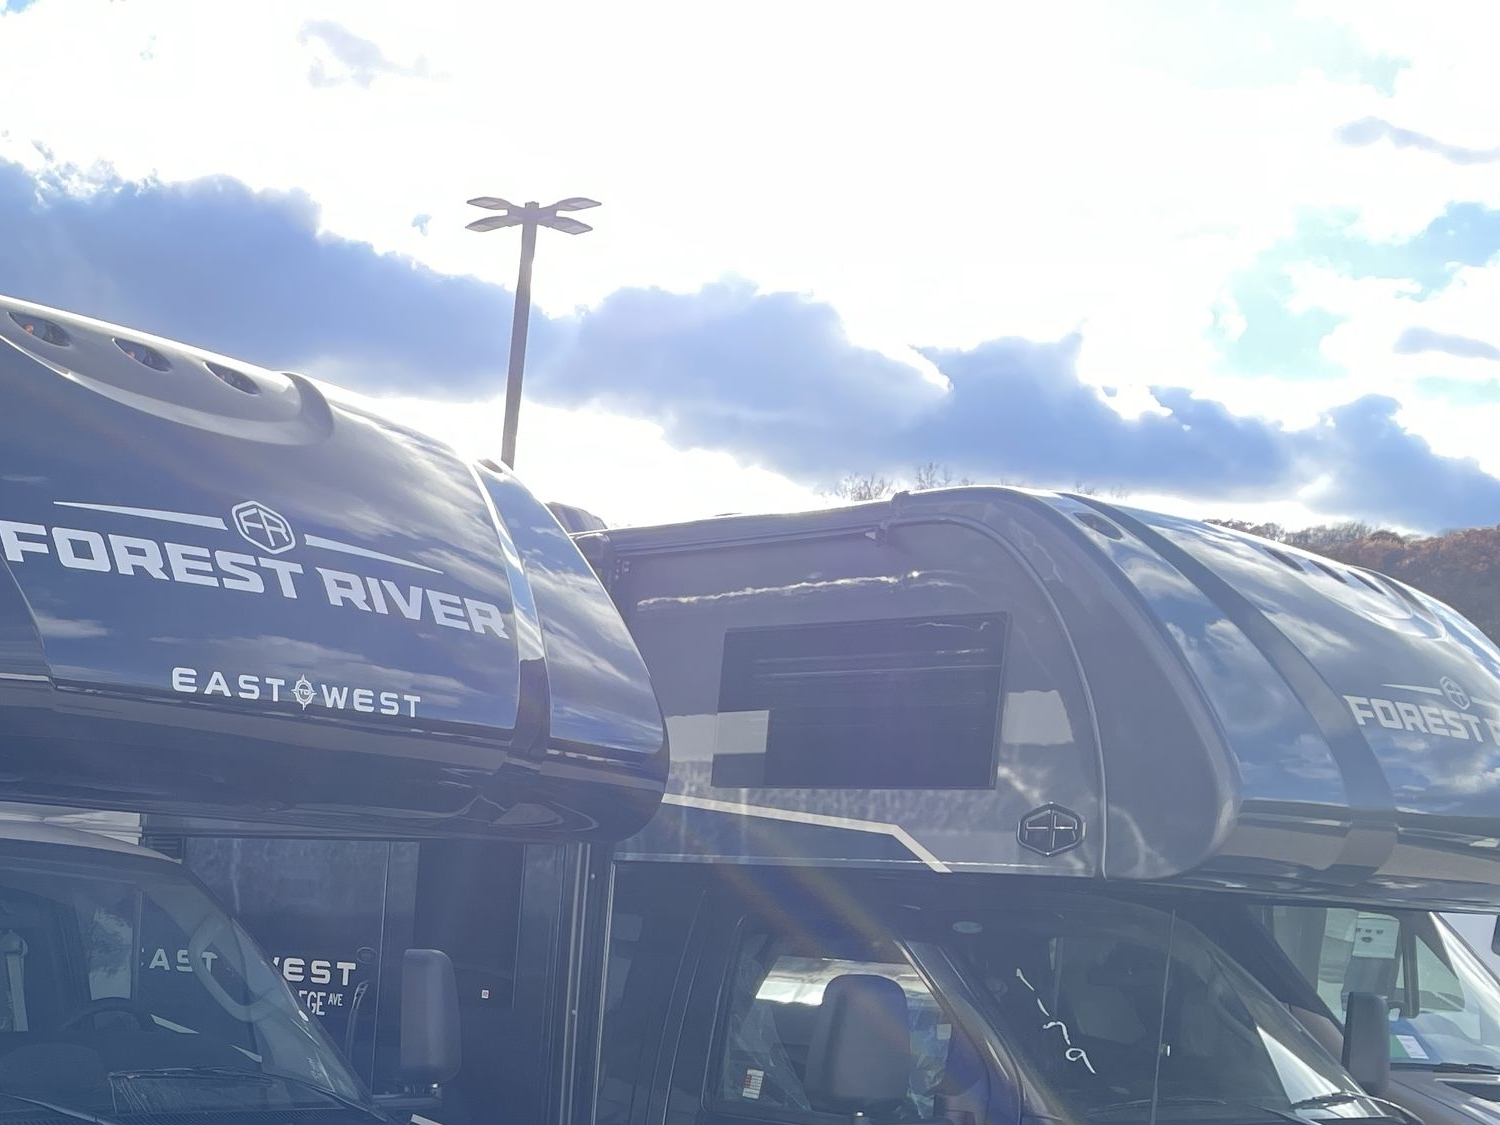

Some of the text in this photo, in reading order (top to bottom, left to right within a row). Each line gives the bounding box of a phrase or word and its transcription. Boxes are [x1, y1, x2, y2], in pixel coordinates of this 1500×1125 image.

[314, 566, 510, 640] RIVER
[171, 666, 285, 702] EAST
[321, 683, 421, 718] WEST
[1342, 694, 1484, 743] FOREST
[140, 947, 219, 974] AST
[327, 992, 344, 1007] AVE
